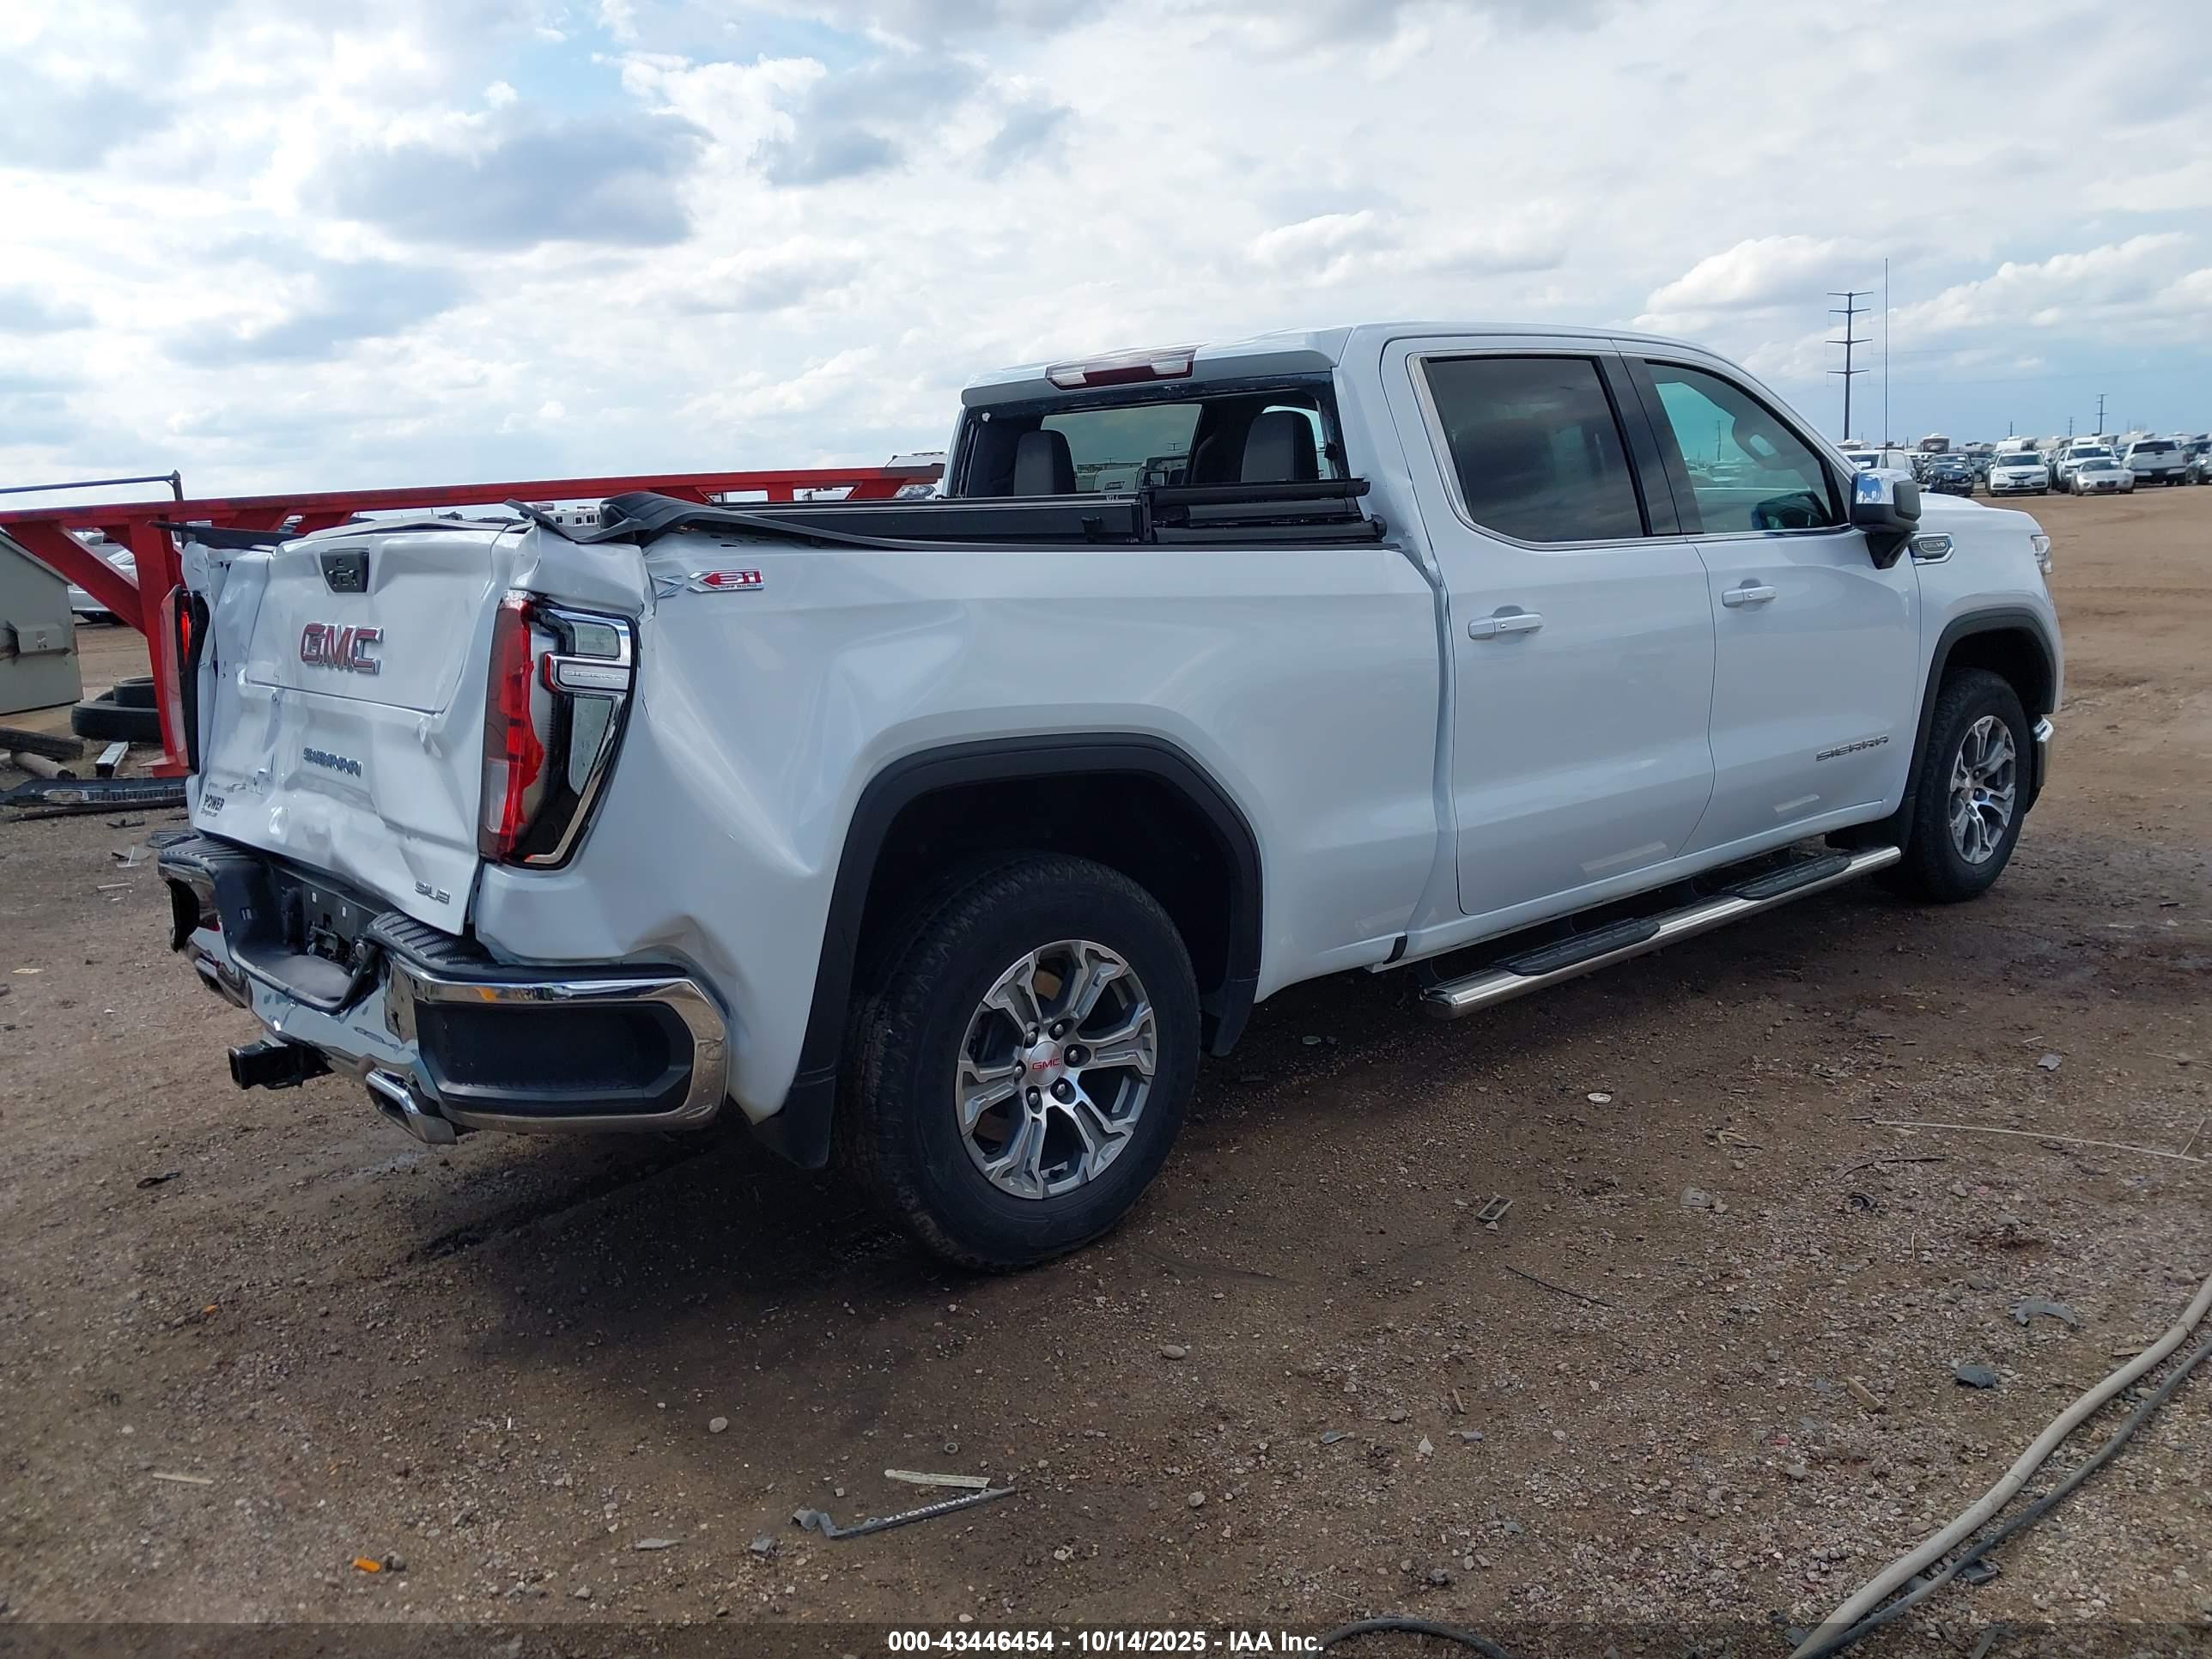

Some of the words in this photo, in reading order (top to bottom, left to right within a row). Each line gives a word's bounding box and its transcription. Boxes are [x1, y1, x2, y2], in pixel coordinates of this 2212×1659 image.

[301, 622, 384, 674] GMC
[1815, 734, 1889, 762] SIERRA
[203, 793, 225, 811] POWER
[414, 880, 452, 906] SLE
[1031, 1057, 1061, 1070] GMC
